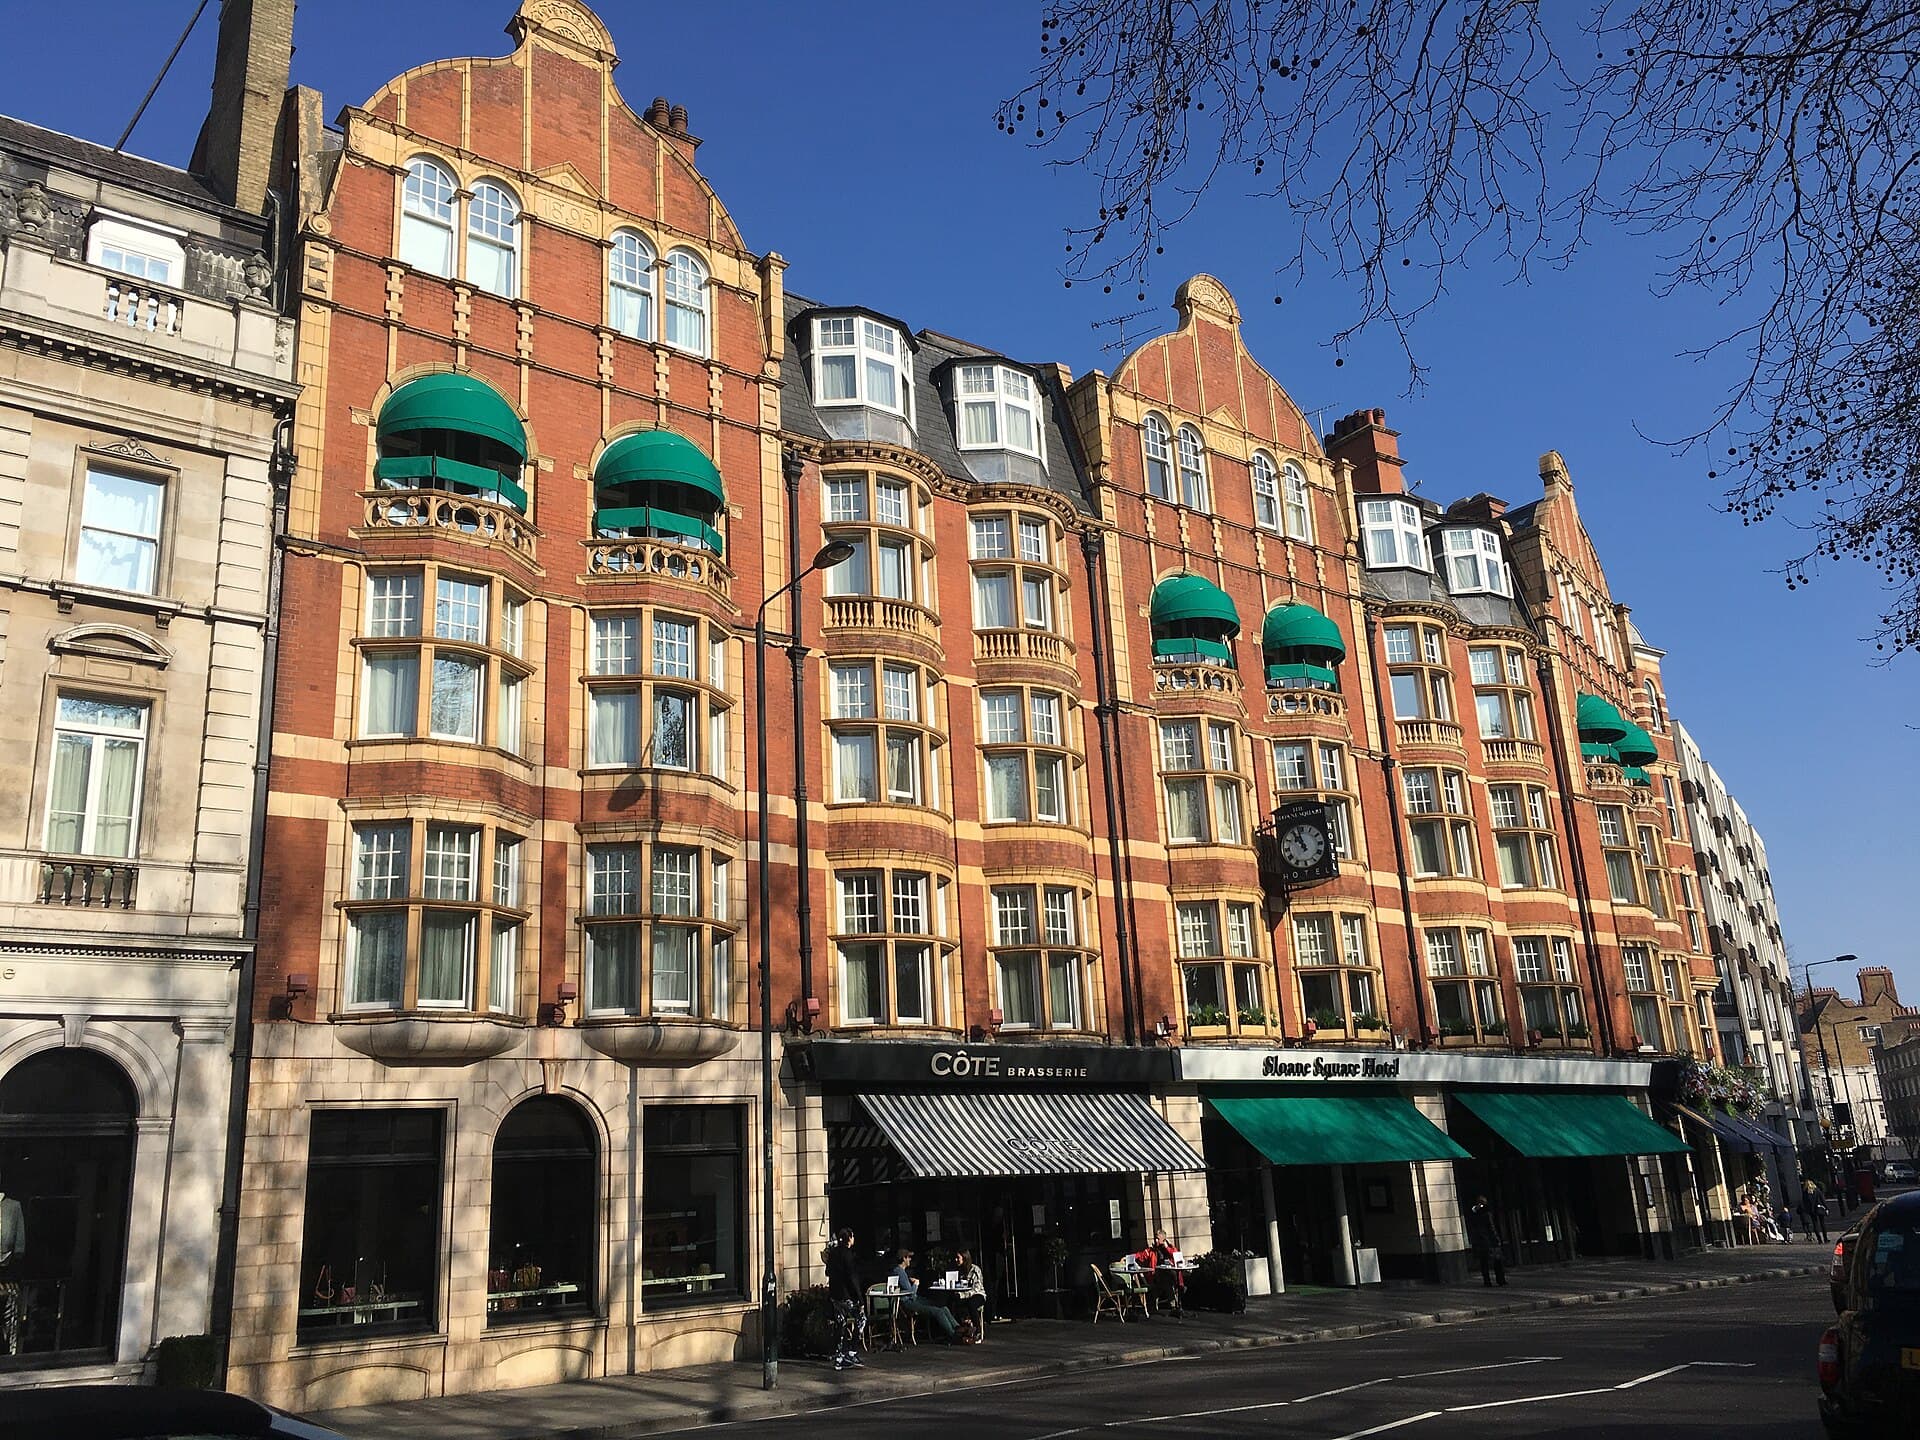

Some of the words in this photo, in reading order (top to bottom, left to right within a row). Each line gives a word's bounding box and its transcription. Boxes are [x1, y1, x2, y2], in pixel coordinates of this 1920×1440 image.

[542, 198, 593, 229] 1895
[1326, 822, 1337, 871] HOTEL
[1283, 867, 1330, 880] HOTEL
[931, 1050, 1001, 1077] CÔTE
[1007, 1067, 1088, 1078] BRASSERIE
[1262, 1055, 1312, 1077] Sloane
[1312, 1056, 1361, 1080] Square
[1361, 1057, 1400, 1078] Hotel
